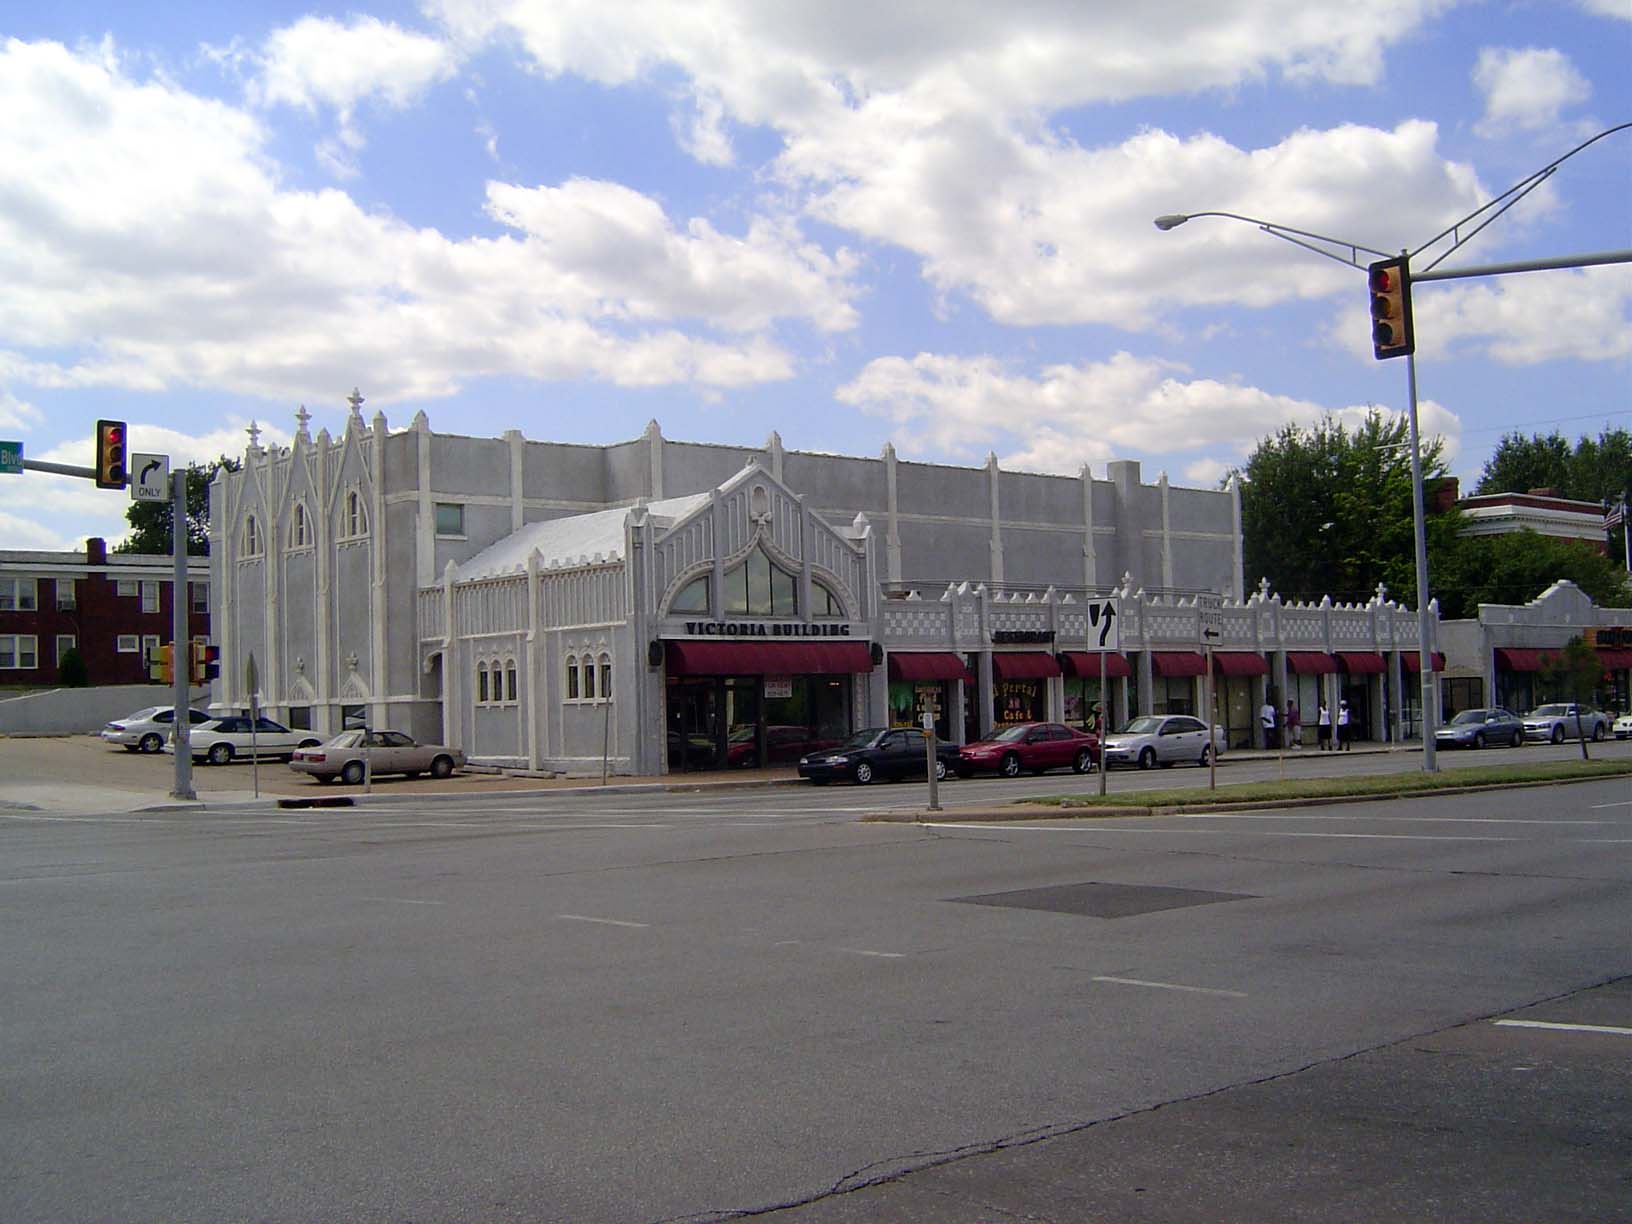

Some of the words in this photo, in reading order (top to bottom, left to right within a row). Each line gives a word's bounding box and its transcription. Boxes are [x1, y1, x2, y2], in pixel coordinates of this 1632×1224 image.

[139, 487, 161, 497] ONLY
[1200, 596, 1221, 609] TRUCK
[1200, 612, 1223, 624] ROUTE
[686, 622, 767, 636] VICTORIA
[773, 623, 849, 637] BUILDING
